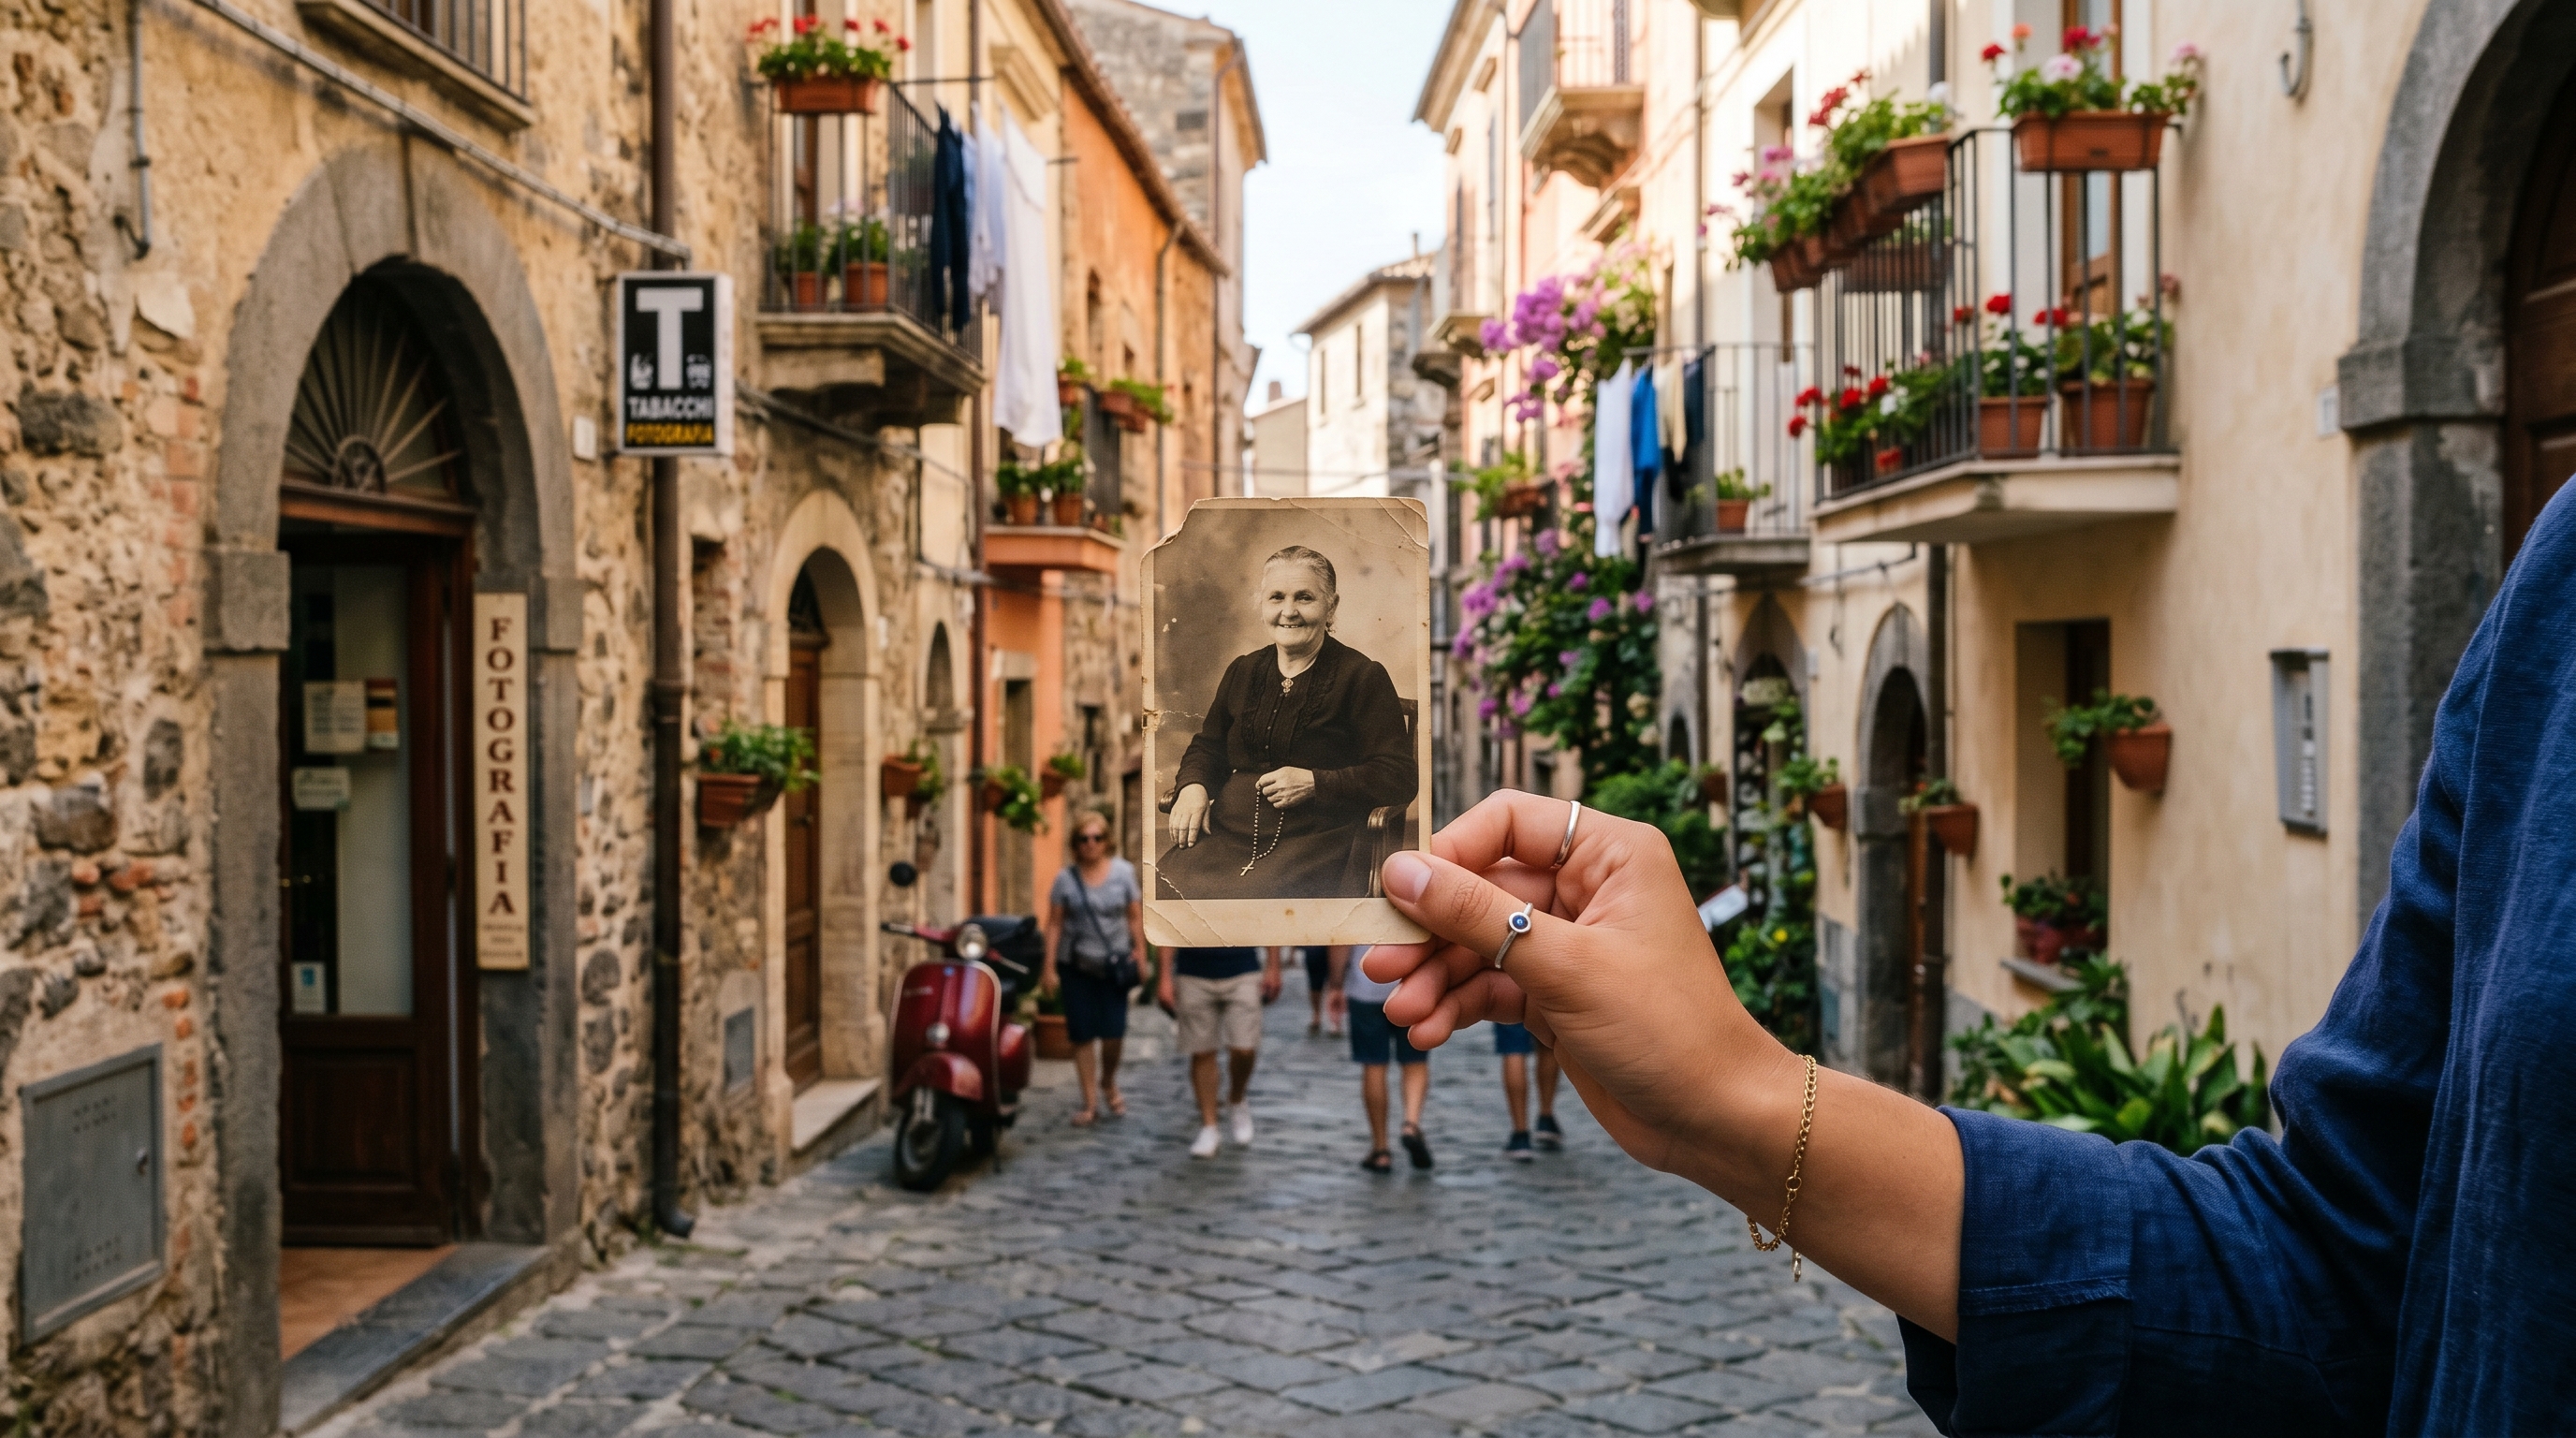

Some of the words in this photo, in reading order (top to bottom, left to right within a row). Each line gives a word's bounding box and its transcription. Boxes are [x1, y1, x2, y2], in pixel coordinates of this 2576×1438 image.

[636, 287, 704, 390] T
[628, 396, 714, 419] TABACCHI
[486, 617, 516, 915] FOTOGRAFIA
